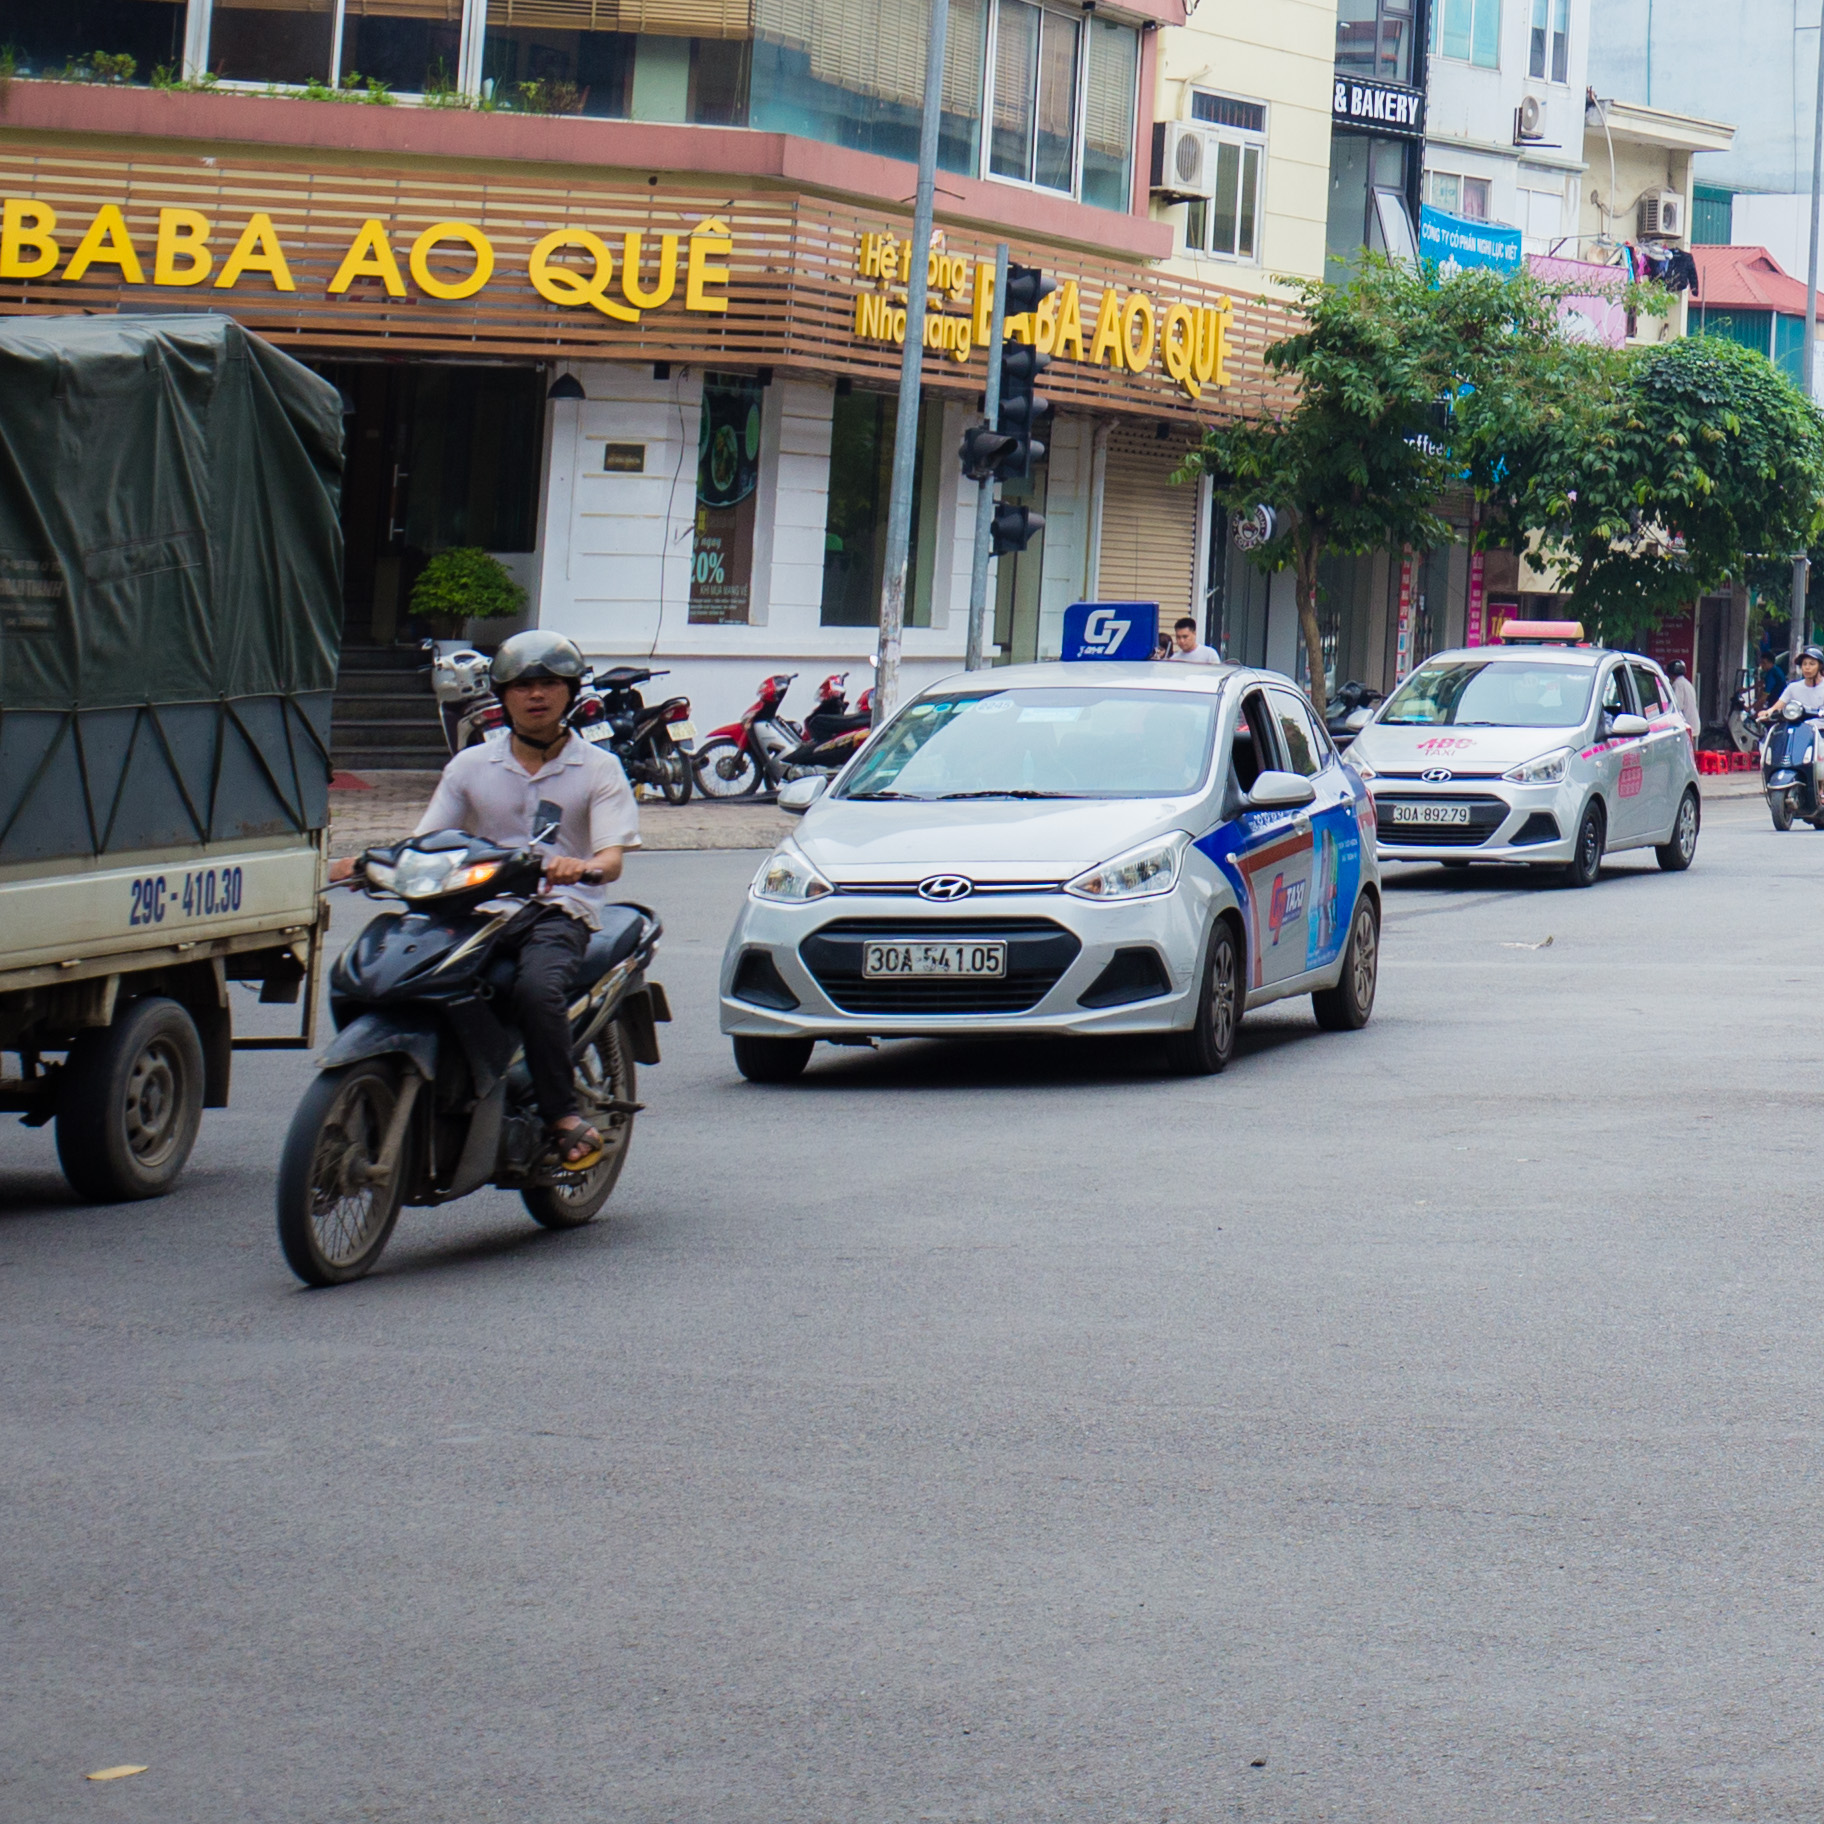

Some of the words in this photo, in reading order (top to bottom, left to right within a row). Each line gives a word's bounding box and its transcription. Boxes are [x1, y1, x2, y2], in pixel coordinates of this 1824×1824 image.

[1334, 82, 1348, 114] &
[1350, 86, 1419, 125] BAKERY
[0, 198, 296, 292] BABA
[328, 219, 494, 300] AO
[530, 218, 733, 323] QUÊ
[859, 230, 896, 290] Hệ
[923, 297, 972, 363] àng
[1089, 288, 1154, 373] AO
[1160, 294, 1234, 400] QUÊ
[1084, 609, 1132, 655] G7
[129, 875, 166, 926] 29C
[182, 866, 242, 917] 410.30
[1286, 881, 1305, 912] TAXI
